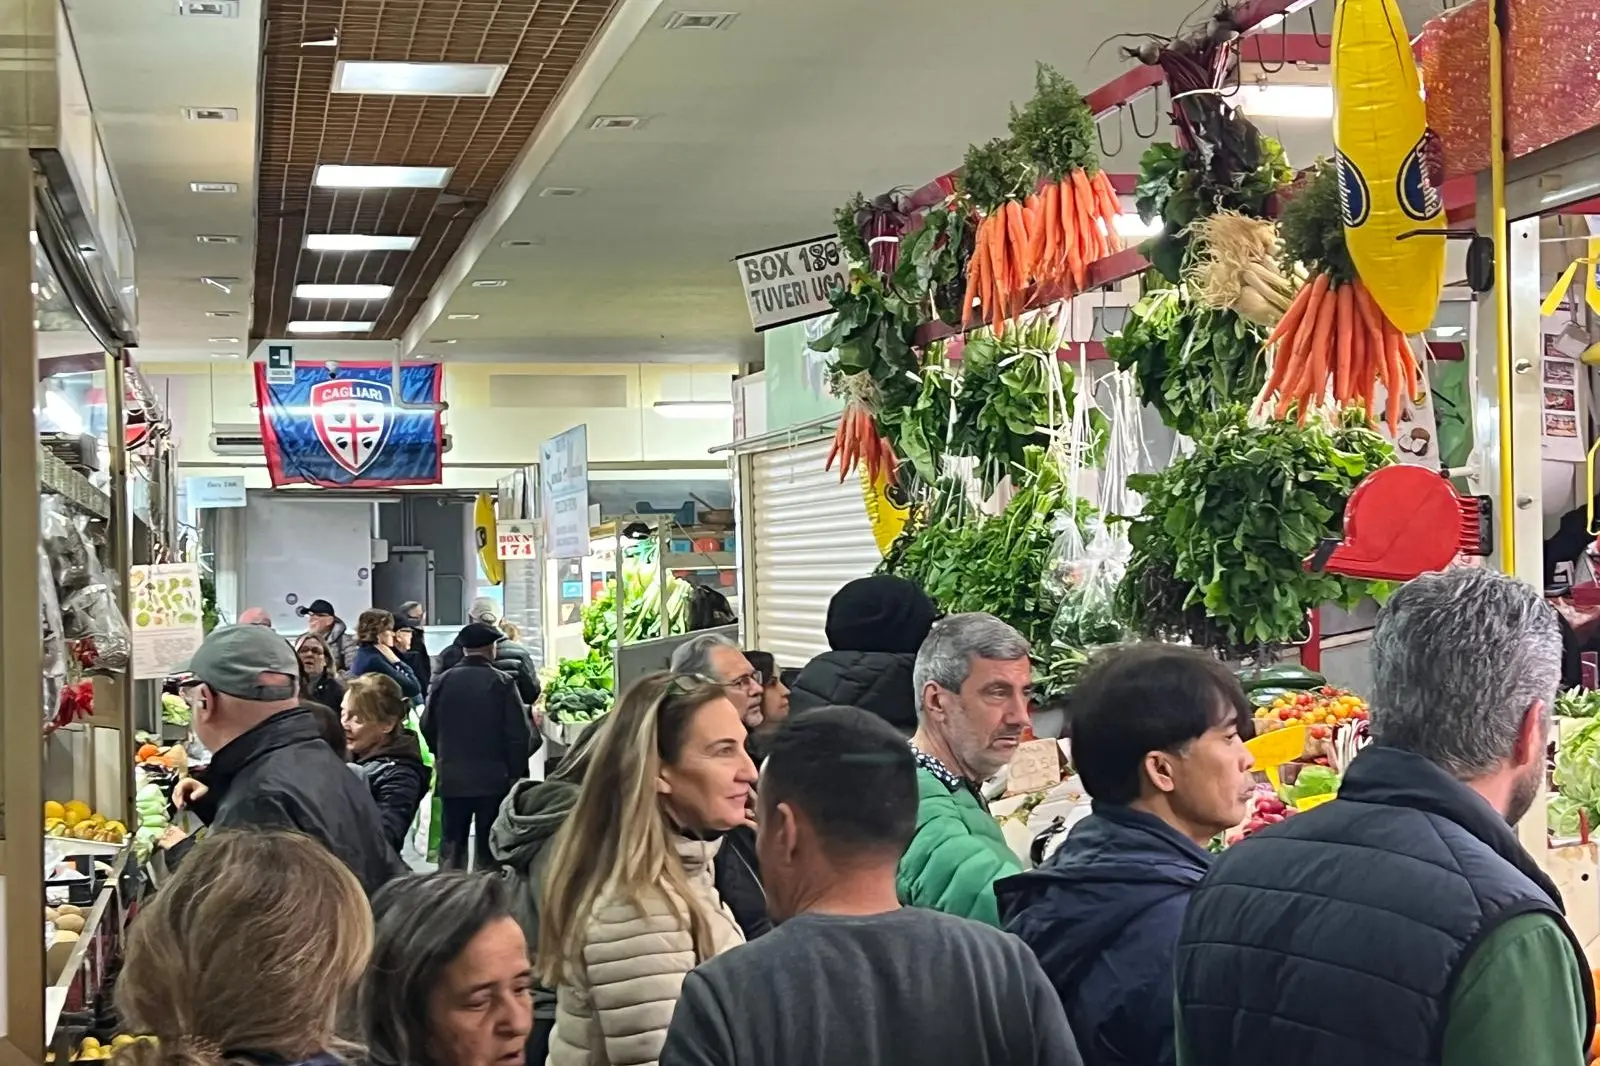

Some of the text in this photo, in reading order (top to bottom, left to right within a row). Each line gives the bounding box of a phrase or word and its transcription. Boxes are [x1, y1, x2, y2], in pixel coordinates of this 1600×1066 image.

[744, 251, 794, 284] BOX
[751, 279, 810, 314] TUVERI
[321, 386, 383, 401] CAGLIARI
[499, 535, 520, 543] BOX
[500, 543, 532, 556] 174
